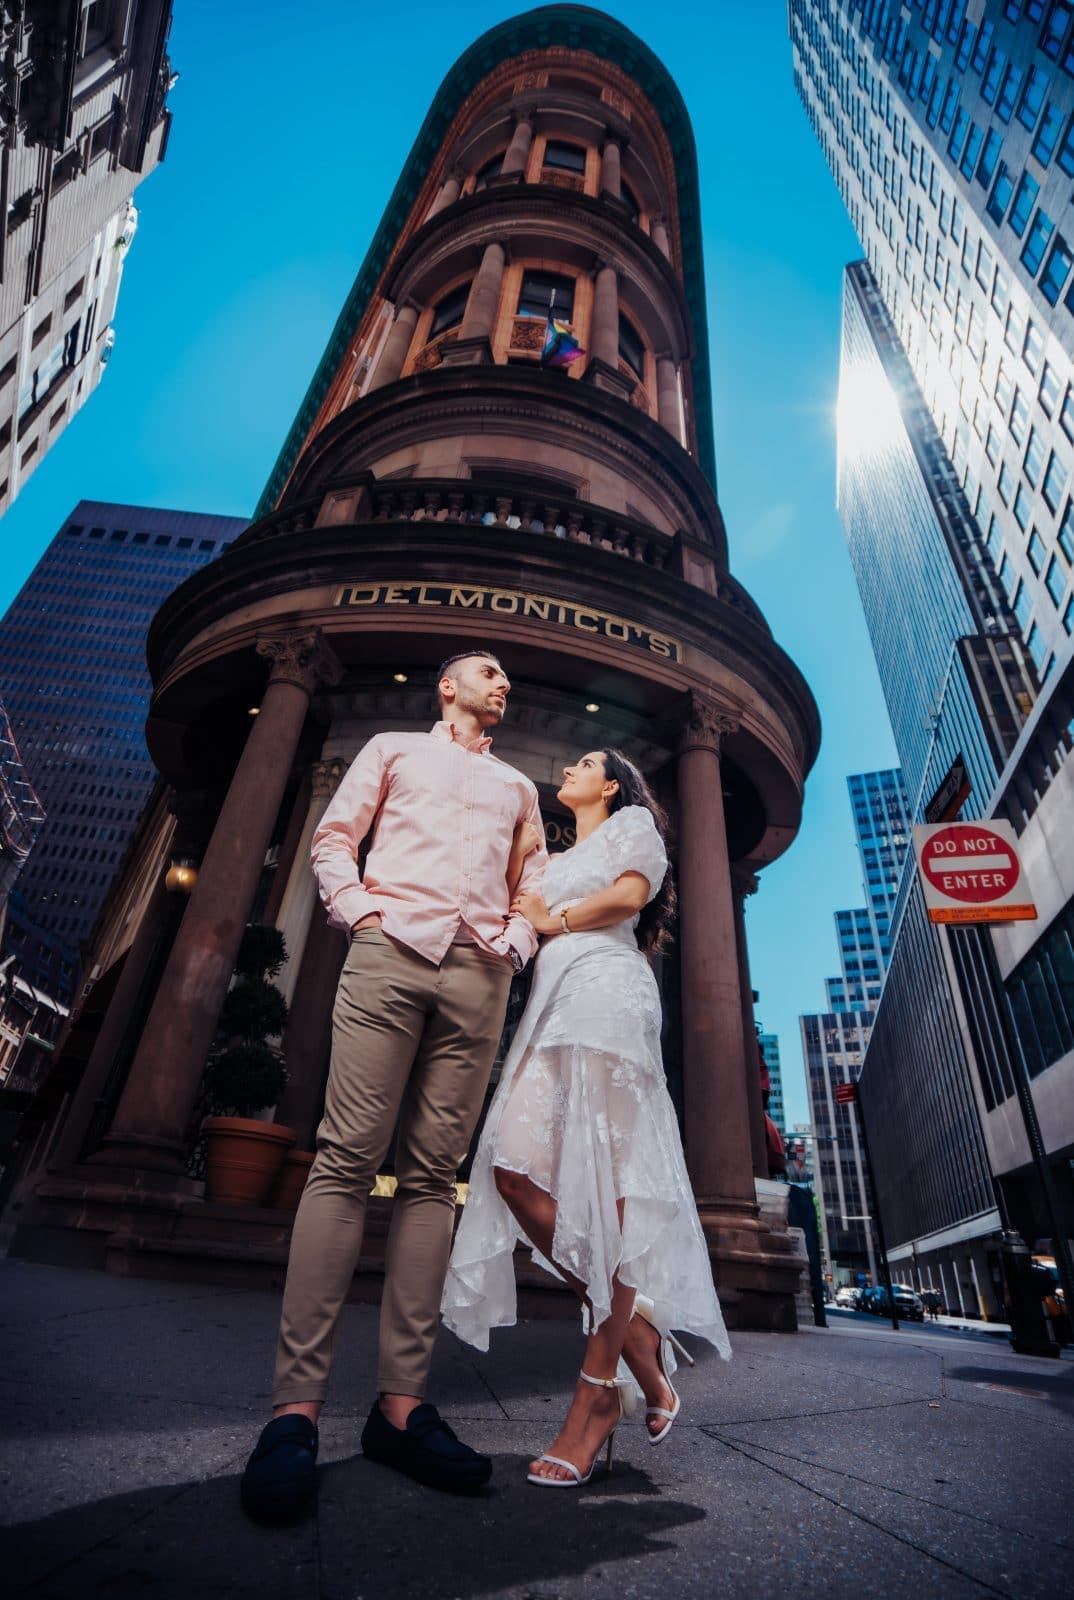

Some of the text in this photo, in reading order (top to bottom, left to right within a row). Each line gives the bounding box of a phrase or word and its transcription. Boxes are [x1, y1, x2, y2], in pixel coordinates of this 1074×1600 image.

[349, 586, 671, 657] DELMONICO'S
[933, 837, 997, 853] DO NOT
[943, 874, 1007, 890] ENTER
